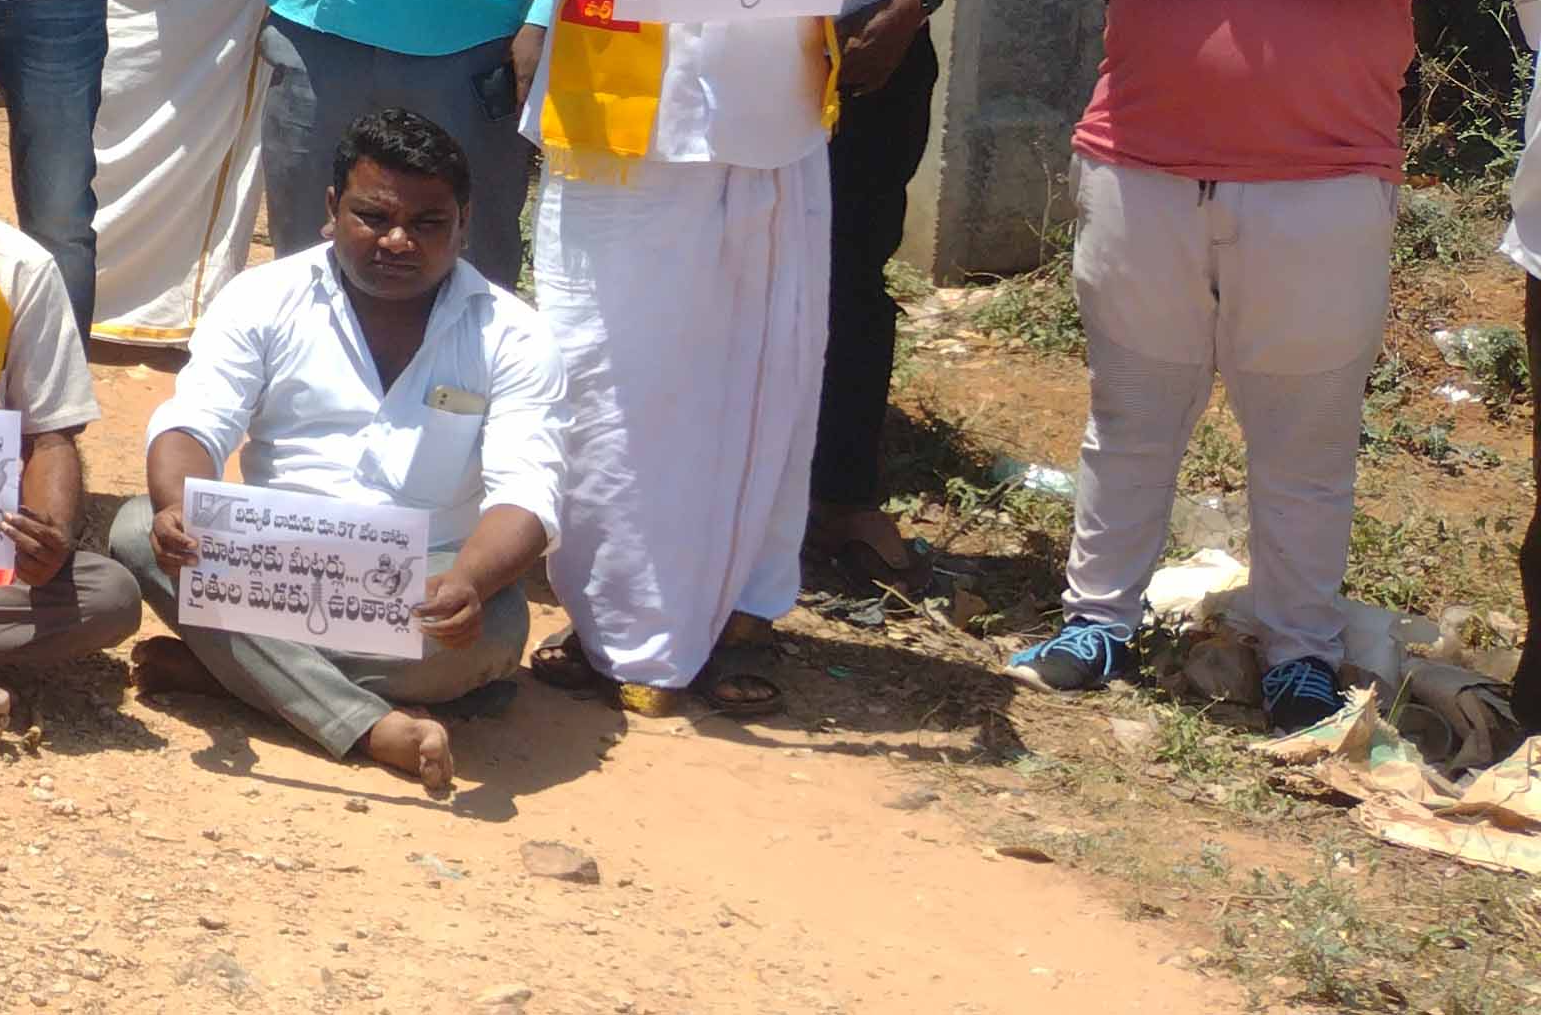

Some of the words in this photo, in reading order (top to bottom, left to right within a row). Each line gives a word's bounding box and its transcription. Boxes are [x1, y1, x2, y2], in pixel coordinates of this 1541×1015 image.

[201, 535, 284, 578] మోటార్లకు
[187, 570, 243, 609] రైతుల
[248, 580, 310, 615] మెడకు
